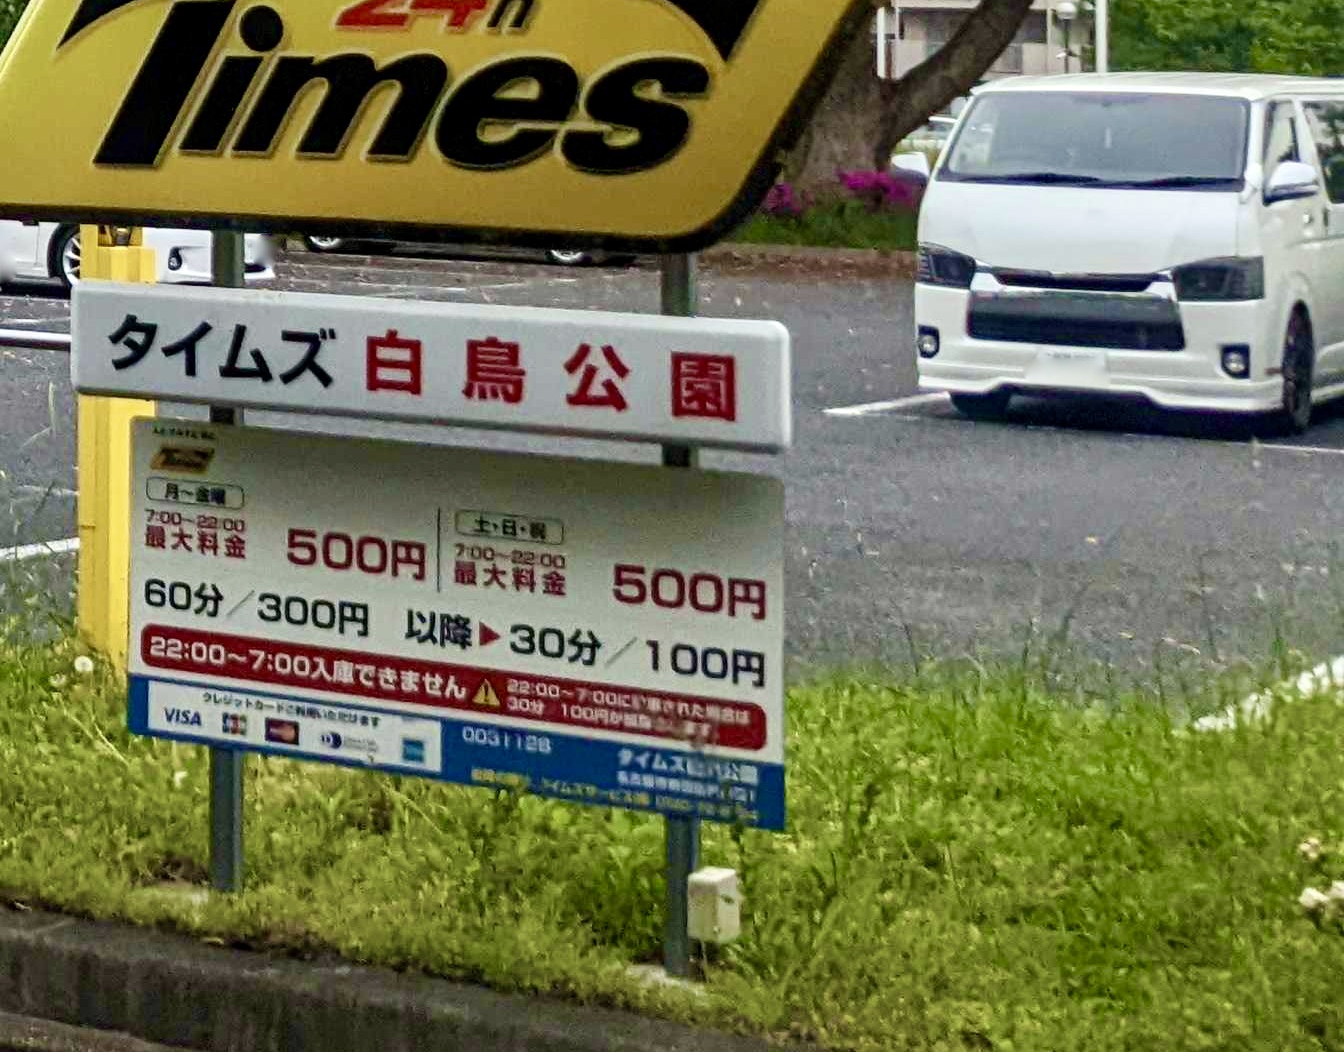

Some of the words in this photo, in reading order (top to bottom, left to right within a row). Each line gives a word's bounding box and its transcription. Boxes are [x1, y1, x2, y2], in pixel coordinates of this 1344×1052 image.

[109, 314, 338, 388] タイムズ
[364, 328, 738, 423] 白鳥公園
[144, 525, 247, 560] 最大料金
[286, 528, 427, 581] 500円
[454, 560, 567, 596] 最大料金
[612, 564, 767, 621] 500円
[405, 609, 473, 650] 以降
[164, 706, 203, 727] VISA
